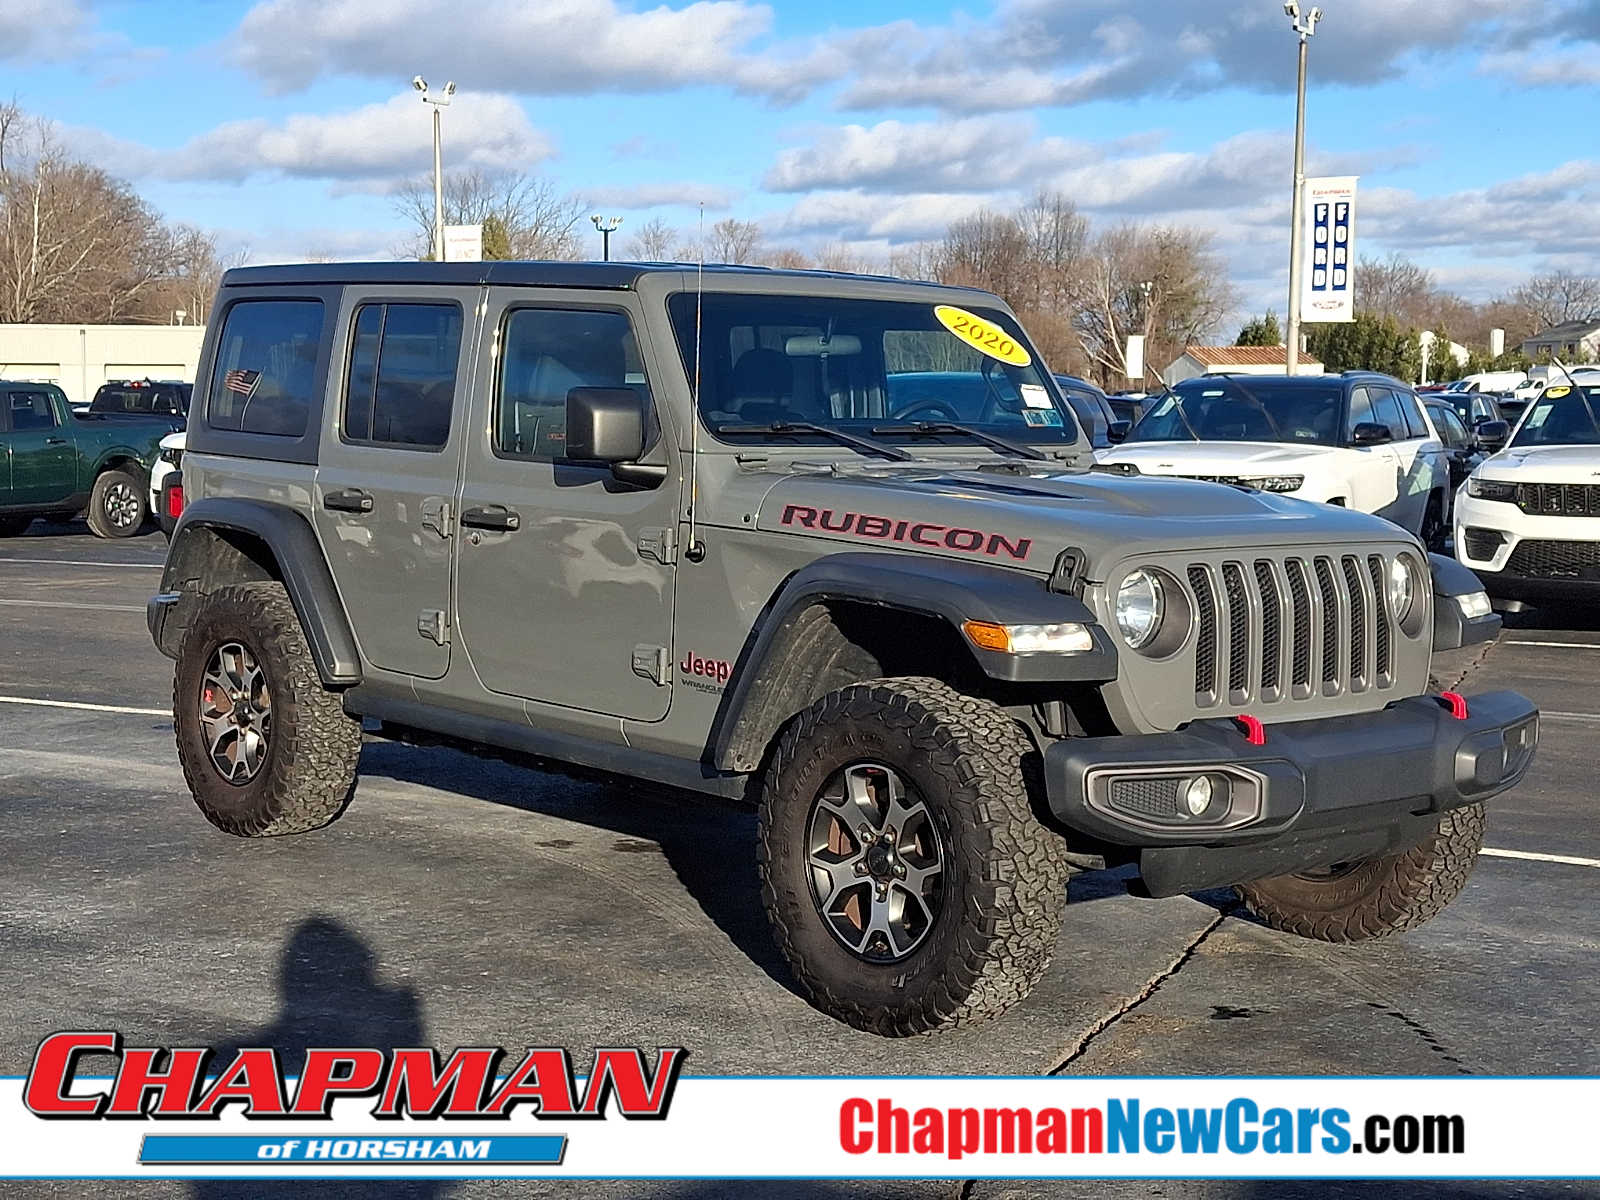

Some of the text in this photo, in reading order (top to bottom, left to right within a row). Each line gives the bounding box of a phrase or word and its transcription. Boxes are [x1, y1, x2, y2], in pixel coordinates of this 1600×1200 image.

[1312, 203, 1328, 287] FORD
[1333, 202, 1349, 286] FORD
[953, 316, 1015, 356] 2020
[780, 504, 1033, 562] RUBICON
[680, 650, 733, 685] Jeep
